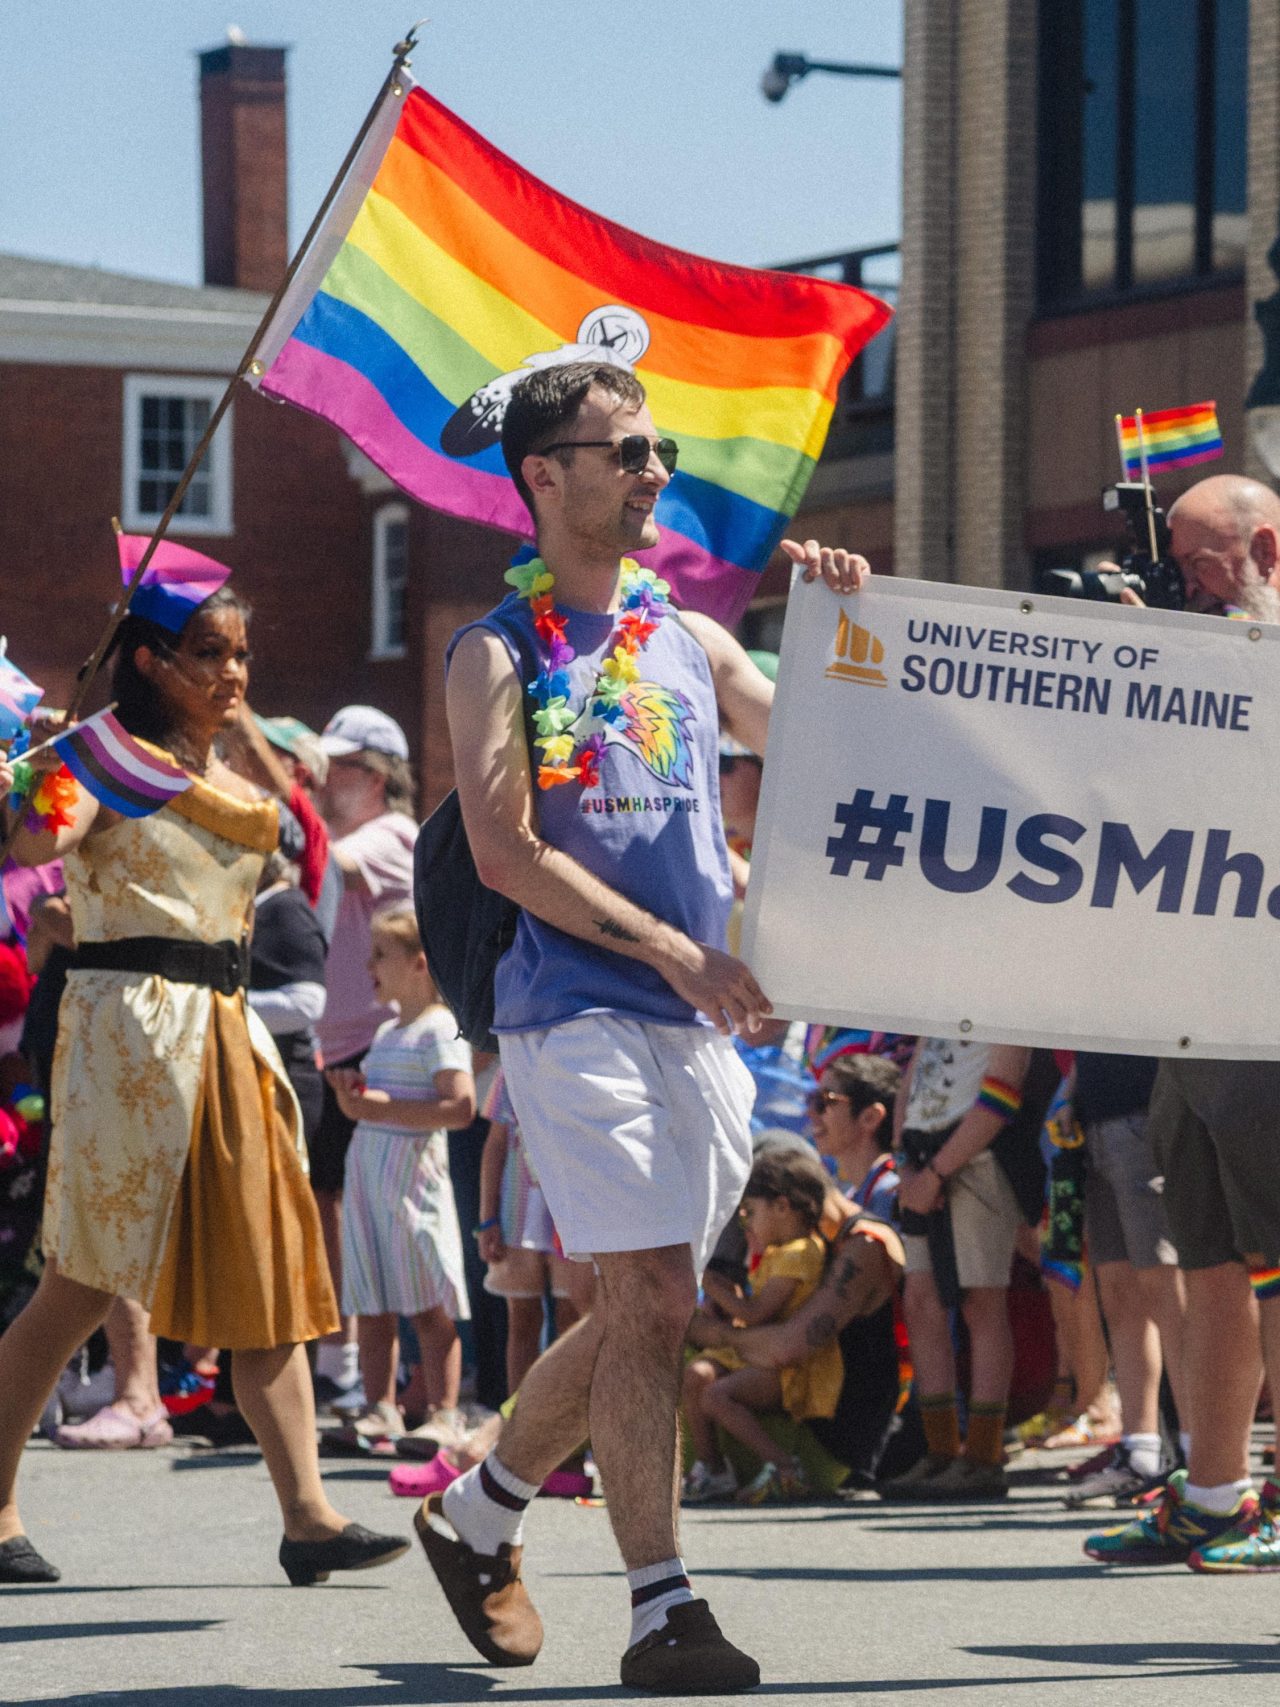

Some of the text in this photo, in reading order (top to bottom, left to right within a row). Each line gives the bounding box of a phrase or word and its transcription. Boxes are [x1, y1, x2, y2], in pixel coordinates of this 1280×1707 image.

[906, 619, 1159, 670] UNIVERSITY OF
[900, 654, 1253, 731] SOUTHERN MAINE
[581, 796, 700, 814] #USMHASPRIDE
